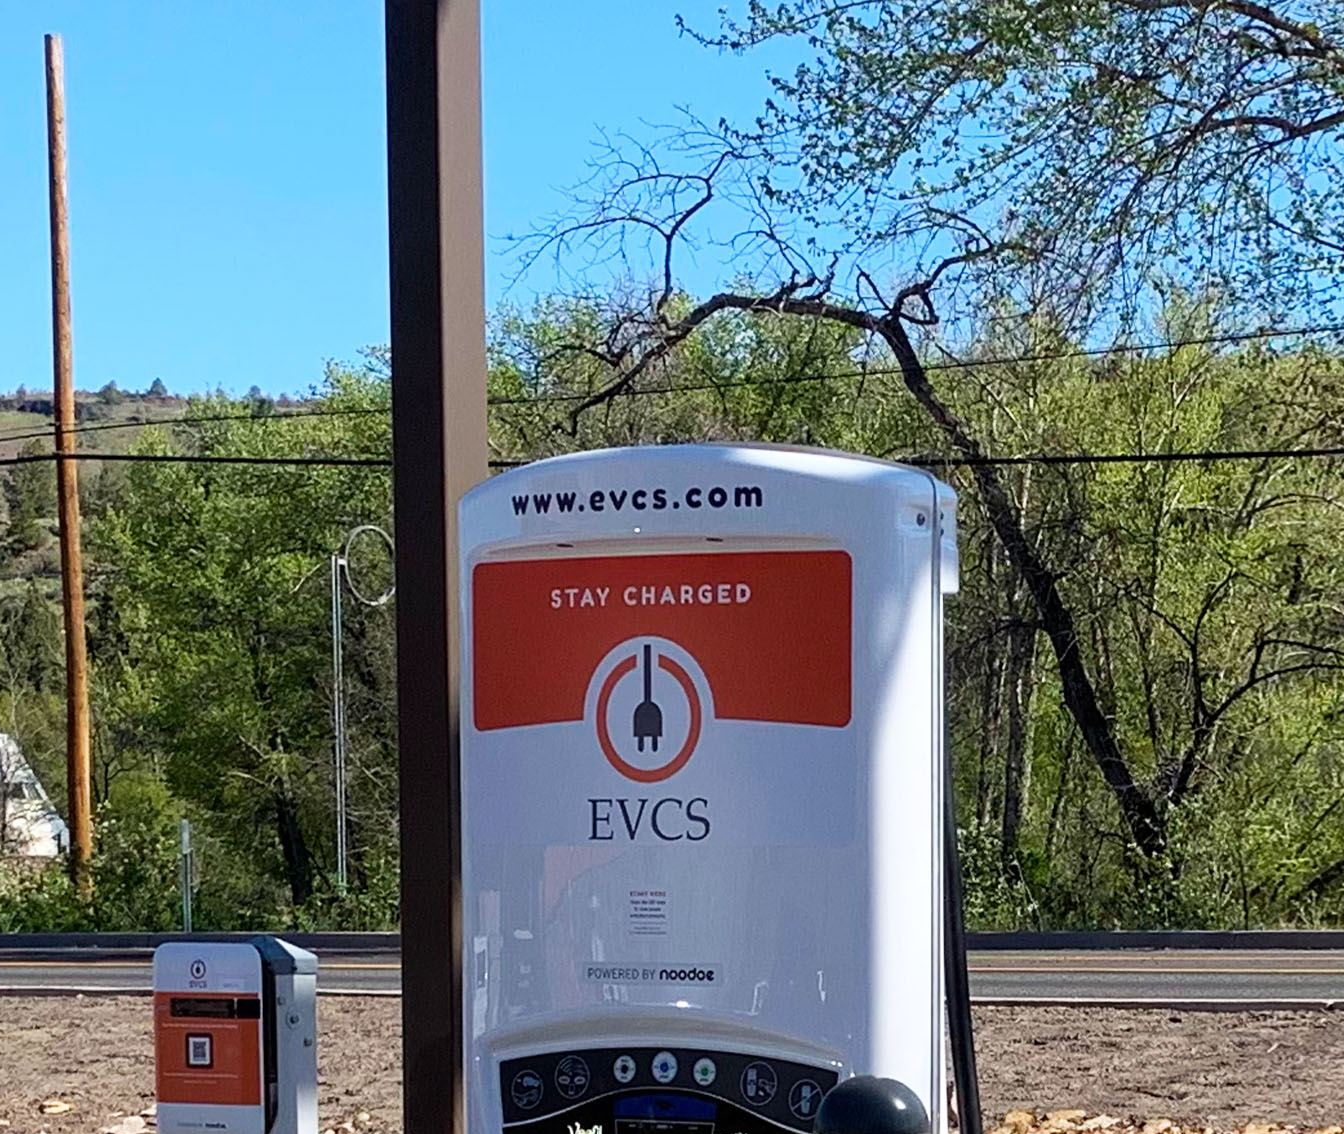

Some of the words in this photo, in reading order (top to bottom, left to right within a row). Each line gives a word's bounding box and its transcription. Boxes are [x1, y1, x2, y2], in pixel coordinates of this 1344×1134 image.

[512, 486, 763, 516] www.evcs.com
[551, 588, 610, 610] STAY
[623, 584, 752, 606] CHARGED
[587, 798, 711, 841] EVCS
[587, 968, 640, 980] POWERED
[642, 969, 656, 980] BY
[659, 968, 715, 981] noodoe
